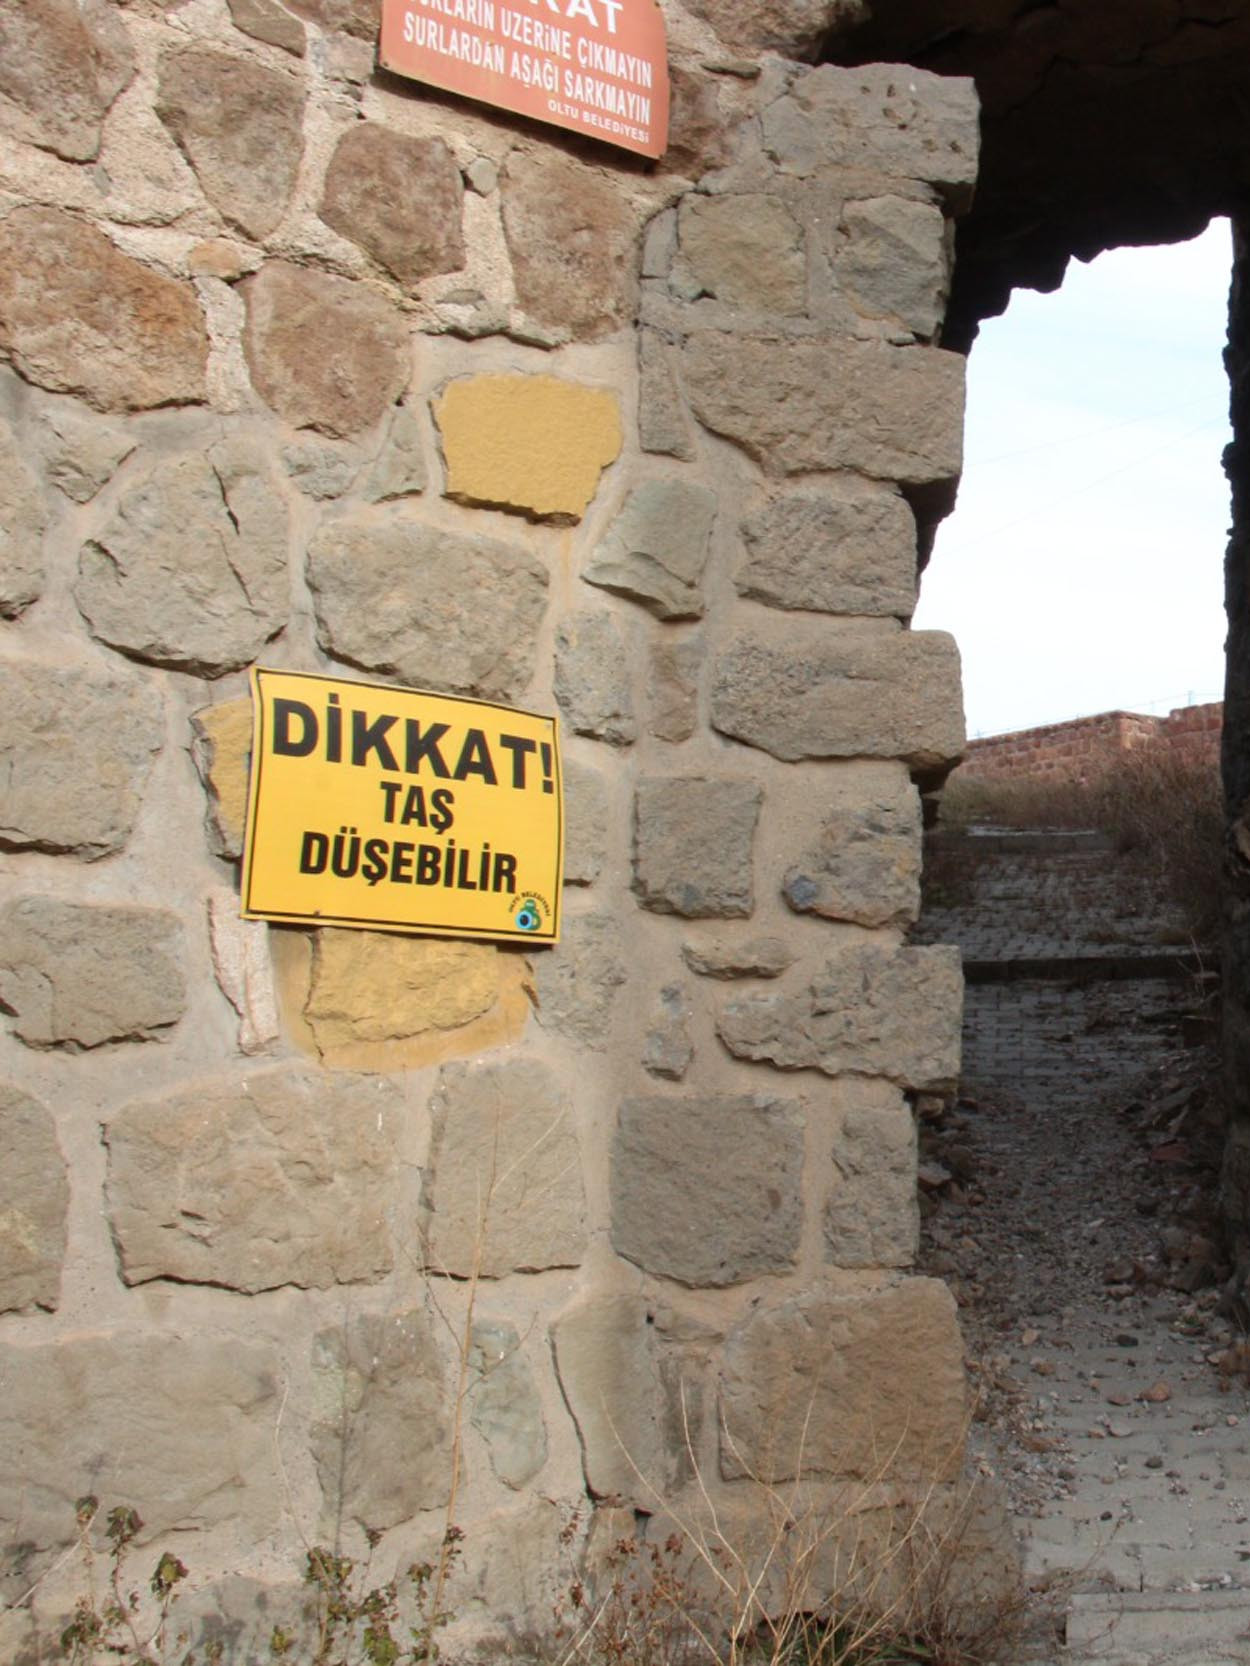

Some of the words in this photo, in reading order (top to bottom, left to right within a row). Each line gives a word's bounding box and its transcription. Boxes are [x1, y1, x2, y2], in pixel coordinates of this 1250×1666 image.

[403, 11, 504, 72] SURLARDAN
[510, 51, 559, 93] AŞAĞI
[564, 69, 650, 126] SARKMAYIN
[578, 37, 652, 89] ÇIKMAYIN
[547, 99, 579, 118] OLTU
[272, 692, 554, 794] DİKKAT!
[380, 781, 454, 836] TAŞ
[299, 826, 518, 894] DÜŞEBİLİR
